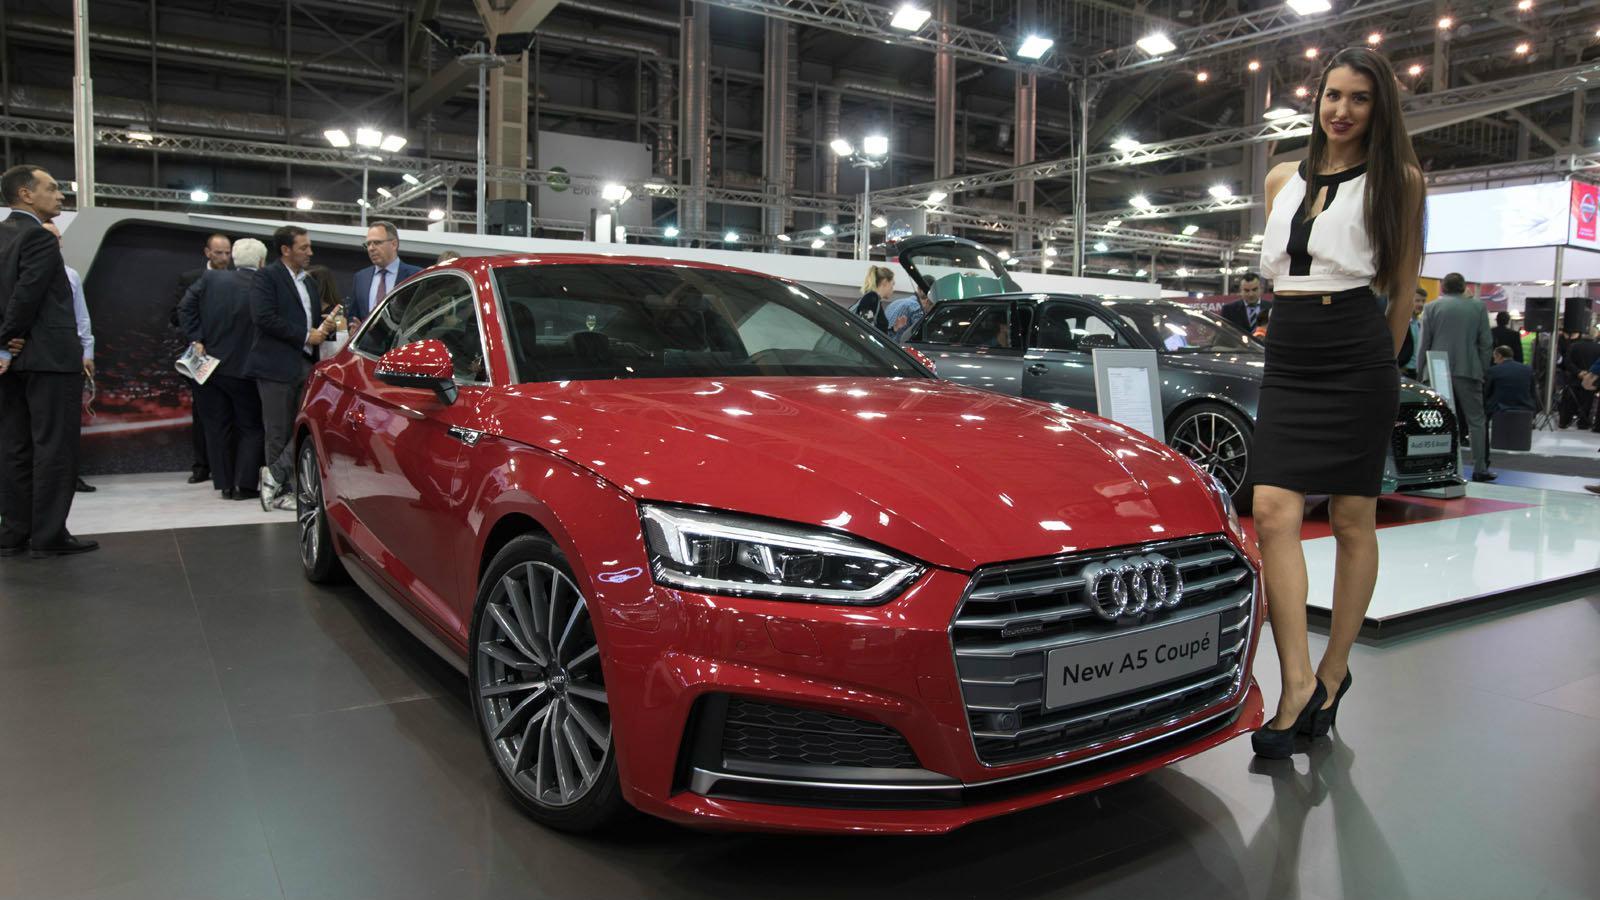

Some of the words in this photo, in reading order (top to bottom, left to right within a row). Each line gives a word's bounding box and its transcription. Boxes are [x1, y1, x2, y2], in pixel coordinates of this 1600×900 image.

[1062, 662, 1114, 686] New
[1119, 649, 1149, 674] A5
[1155, 632, 1211, 664] Coupé
